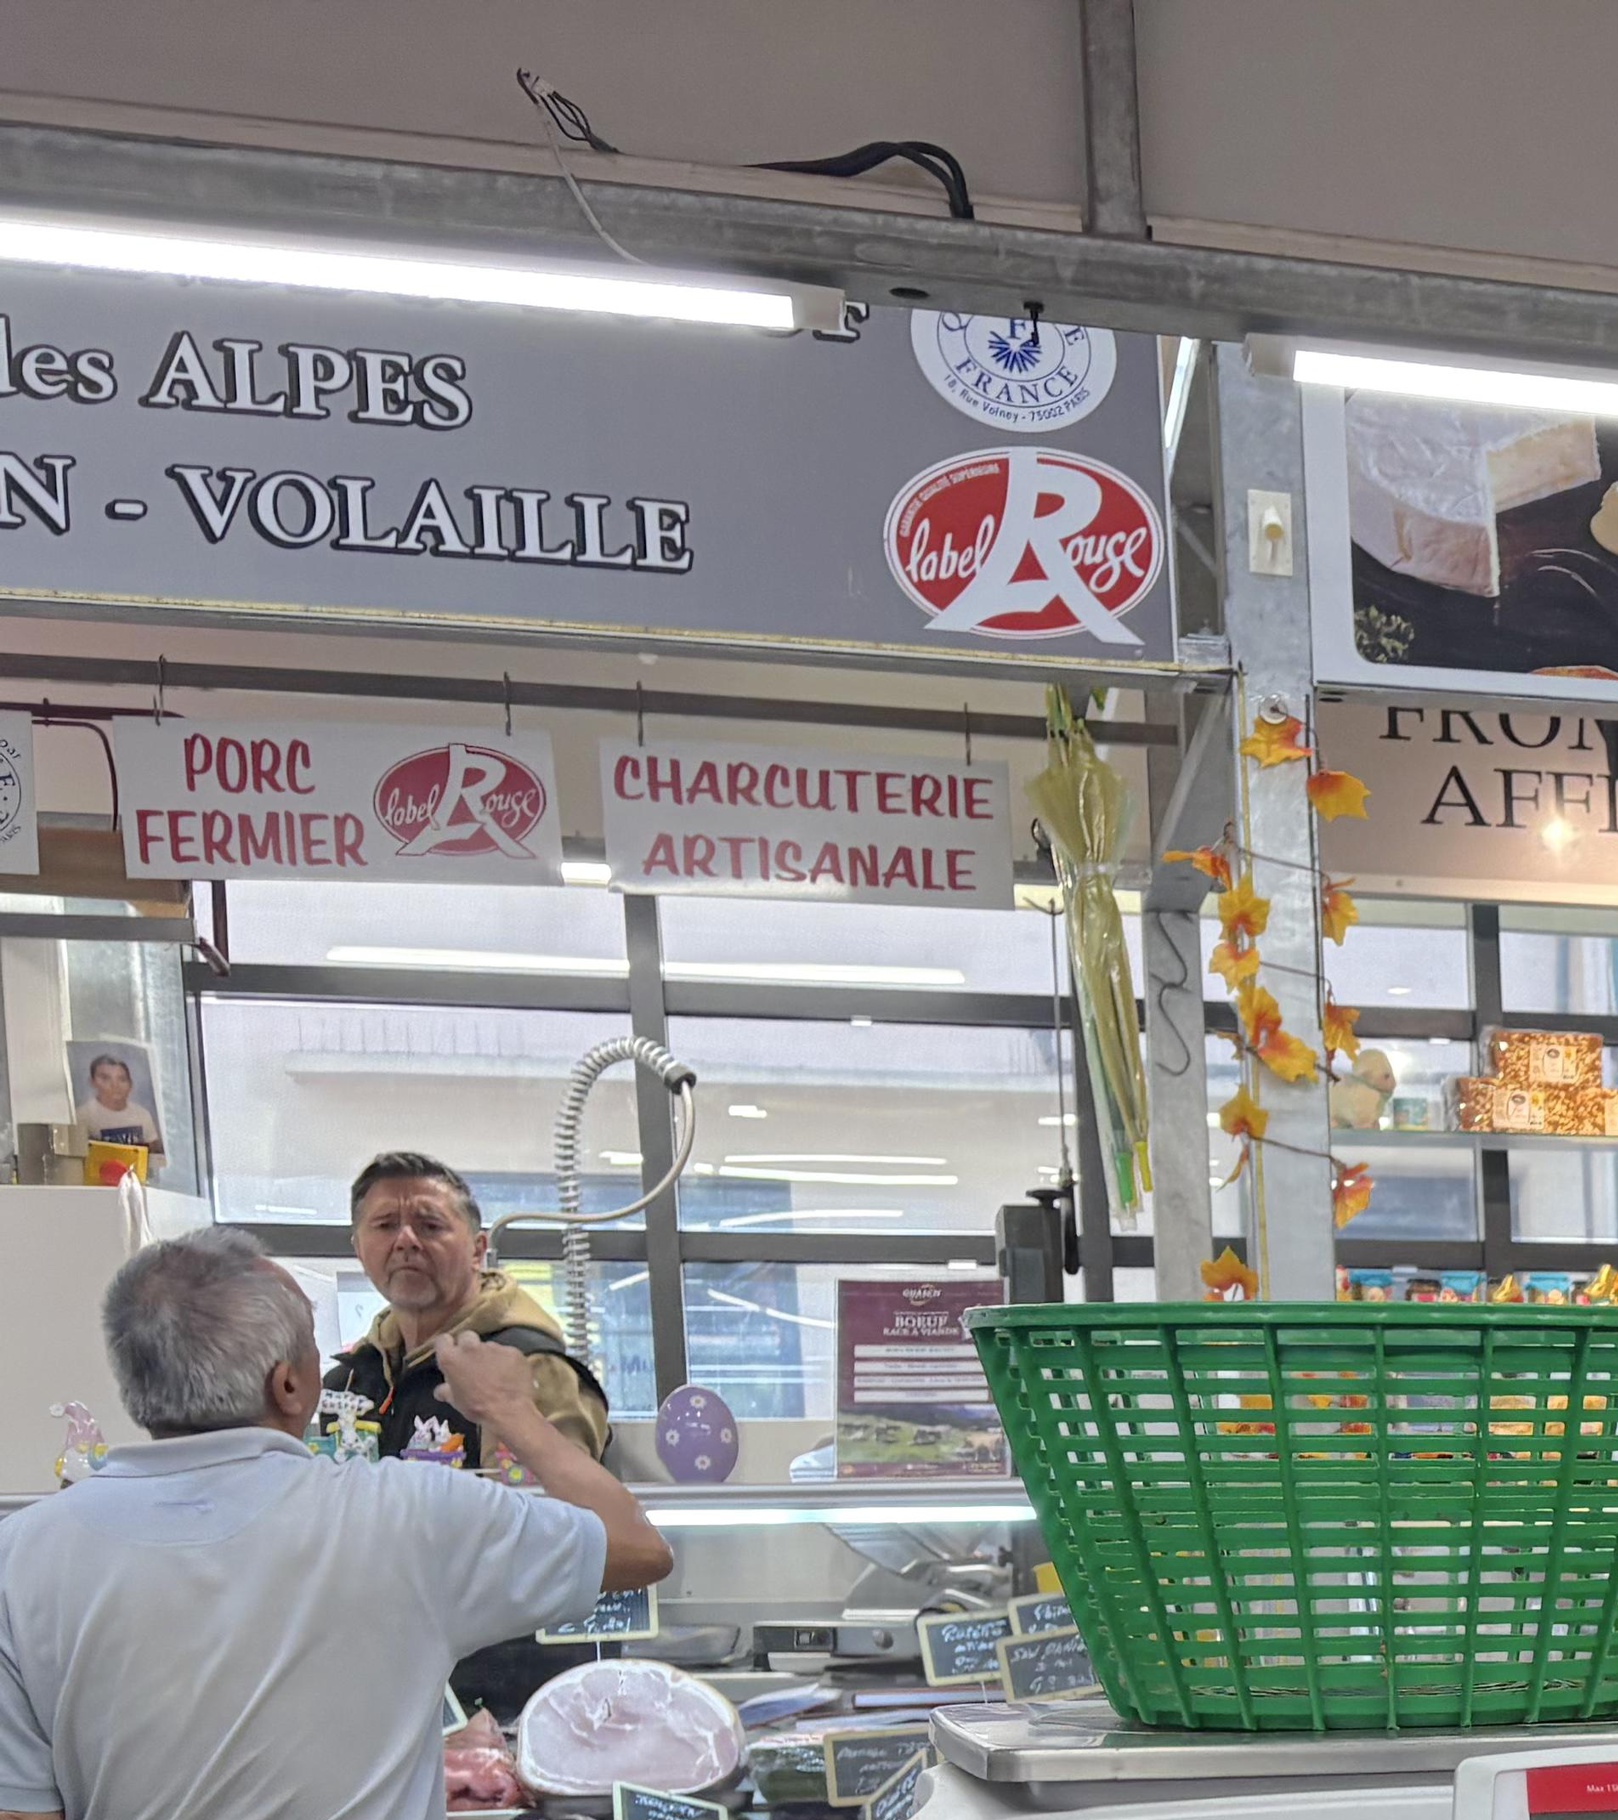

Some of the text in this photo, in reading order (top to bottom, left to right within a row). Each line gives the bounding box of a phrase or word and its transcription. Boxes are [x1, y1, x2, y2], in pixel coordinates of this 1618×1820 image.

[140, 330, 474, 432] ALPES
[955, 357, 1078, 405] FRANCE
[959, 387, 980, 409] Rue
[168, 463, 695, 576] VOLAILLE
[905, 513, 997, 585] label
[183, 733, 316, 795] PORC
[613, 753, 994, 821] CHARCUTERIE
[136, 808, 369, 869] FERMIER
[641, 832, 978, 892] ARTISANALE
[1586, 1783, 1605, 1794] Max
